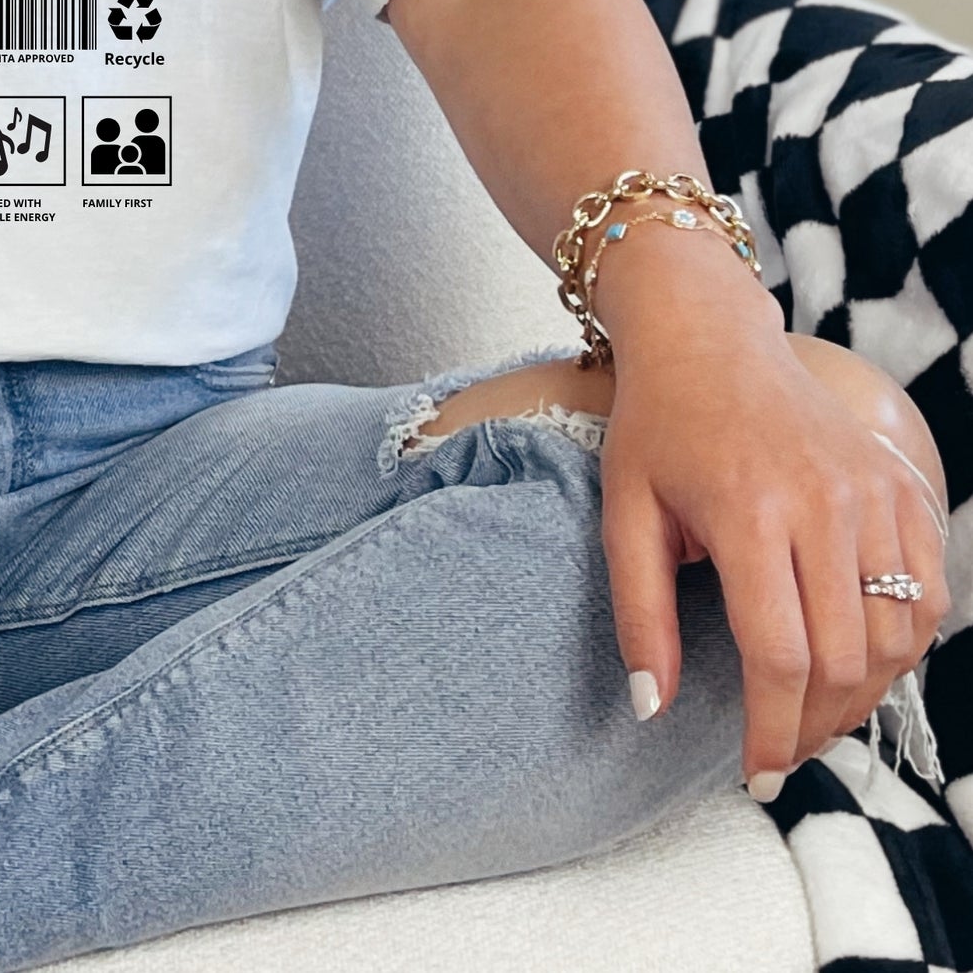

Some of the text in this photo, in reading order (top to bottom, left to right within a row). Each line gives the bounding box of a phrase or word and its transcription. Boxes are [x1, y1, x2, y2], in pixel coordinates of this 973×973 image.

[17, 53, 75, 64] APPROVED
[104, 51, 165, 70] Recycle
[13, 198, 42, 208] WITH
[82, 198, 153, 208] FAMILY FIRST
[14, 212, 56, 222] ENERGY
